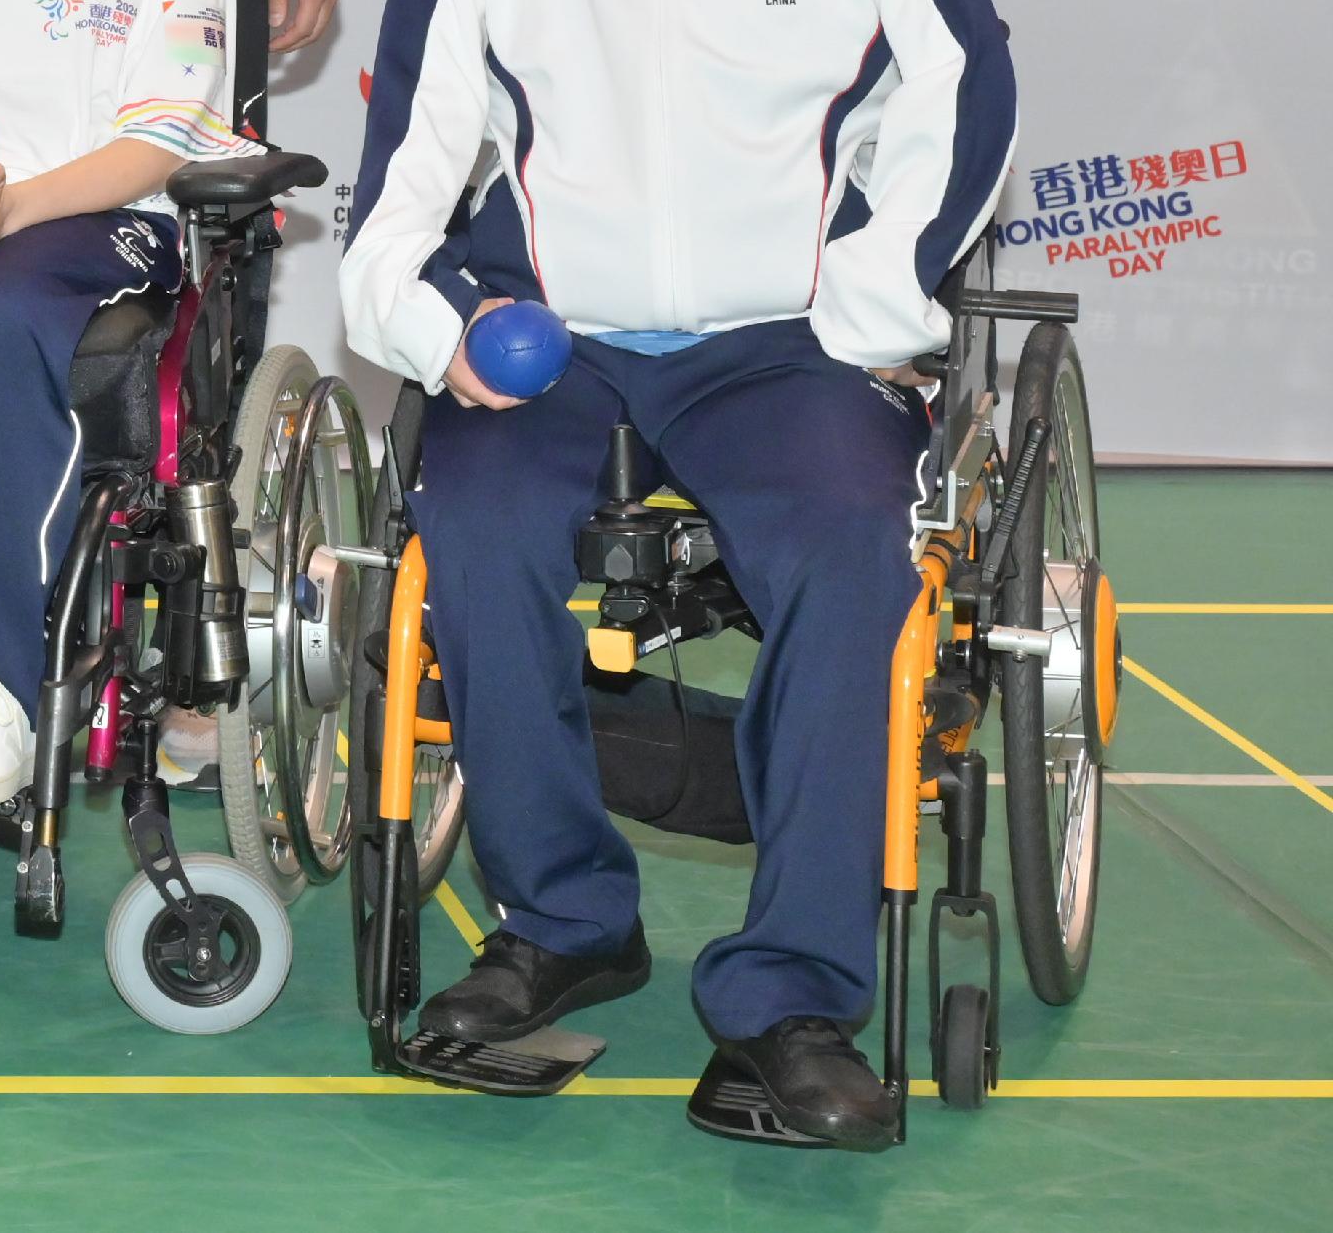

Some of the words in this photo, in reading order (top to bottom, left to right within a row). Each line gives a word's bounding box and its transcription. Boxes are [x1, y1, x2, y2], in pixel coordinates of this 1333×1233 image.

[1030, 140, 1247, 212] 香港殘奧日
[1089, 191, 1193, 232] KONG
[110, 234, 130, 254] HONG
[130, 252, 149, 273] KONG
[1045, 215, 1222, 265] PARALYMPIC
[1108, 250, 1165, 279] DAY
